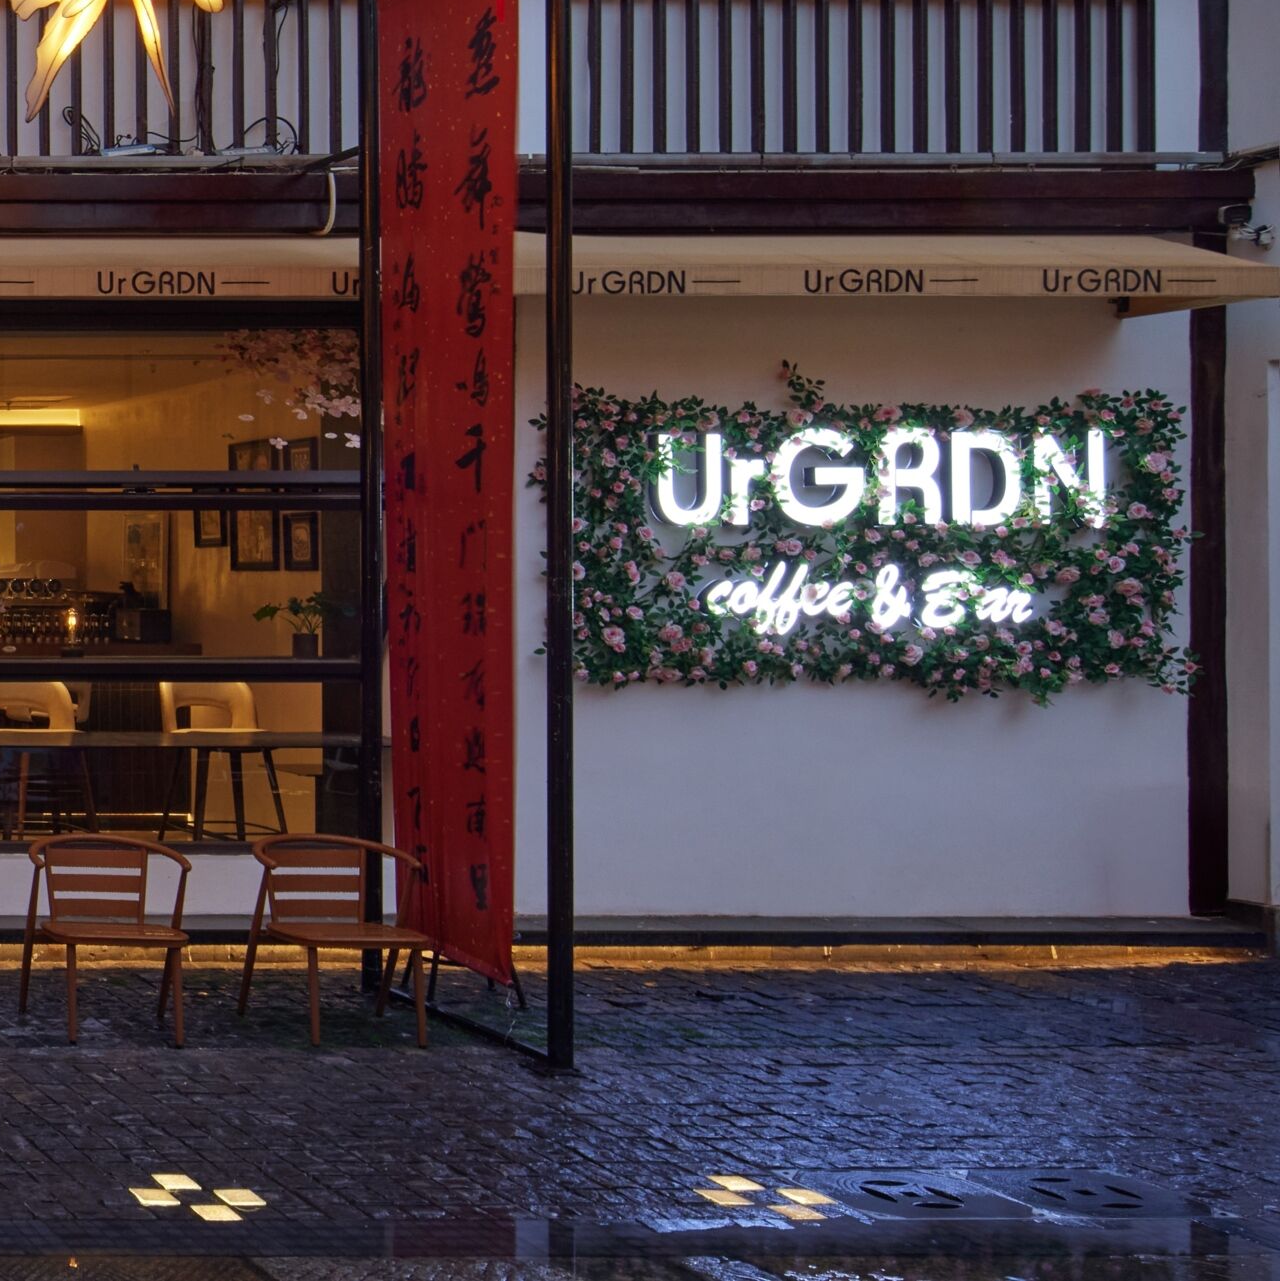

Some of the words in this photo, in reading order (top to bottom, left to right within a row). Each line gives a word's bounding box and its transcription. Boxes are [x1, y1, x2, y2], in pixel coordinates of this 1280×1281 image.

[655, 426, 1109, 530] UrGRDN
[705, 560, 854, 637] coffee
[873, 562, 913, 629] &
[921, 569, 1035, 629] Bar
